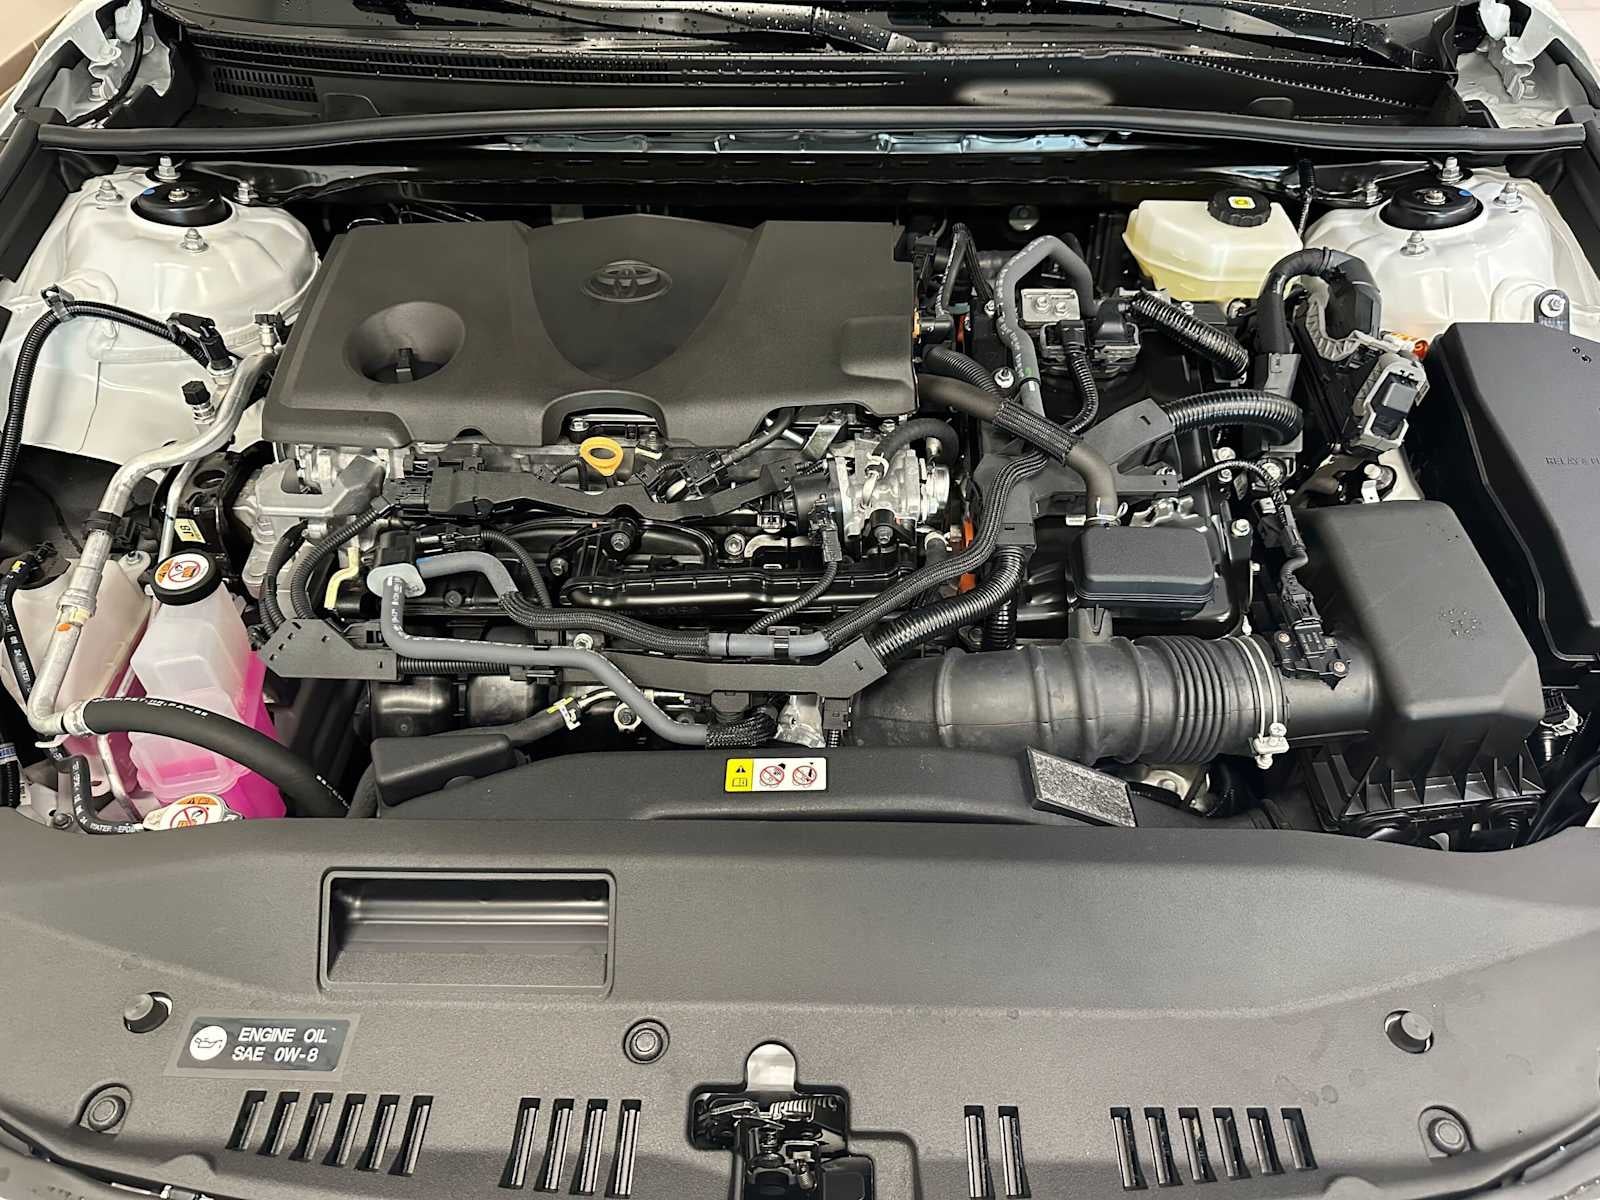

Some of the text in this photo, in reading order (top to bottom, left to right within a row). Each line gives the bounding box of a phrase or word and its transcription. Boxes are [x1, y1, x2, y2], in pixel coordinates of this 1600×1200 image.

[238, 1026, 328, 1044] ENGINE OIL
[231, 1045, 319, 1063] SAE 0W-8
